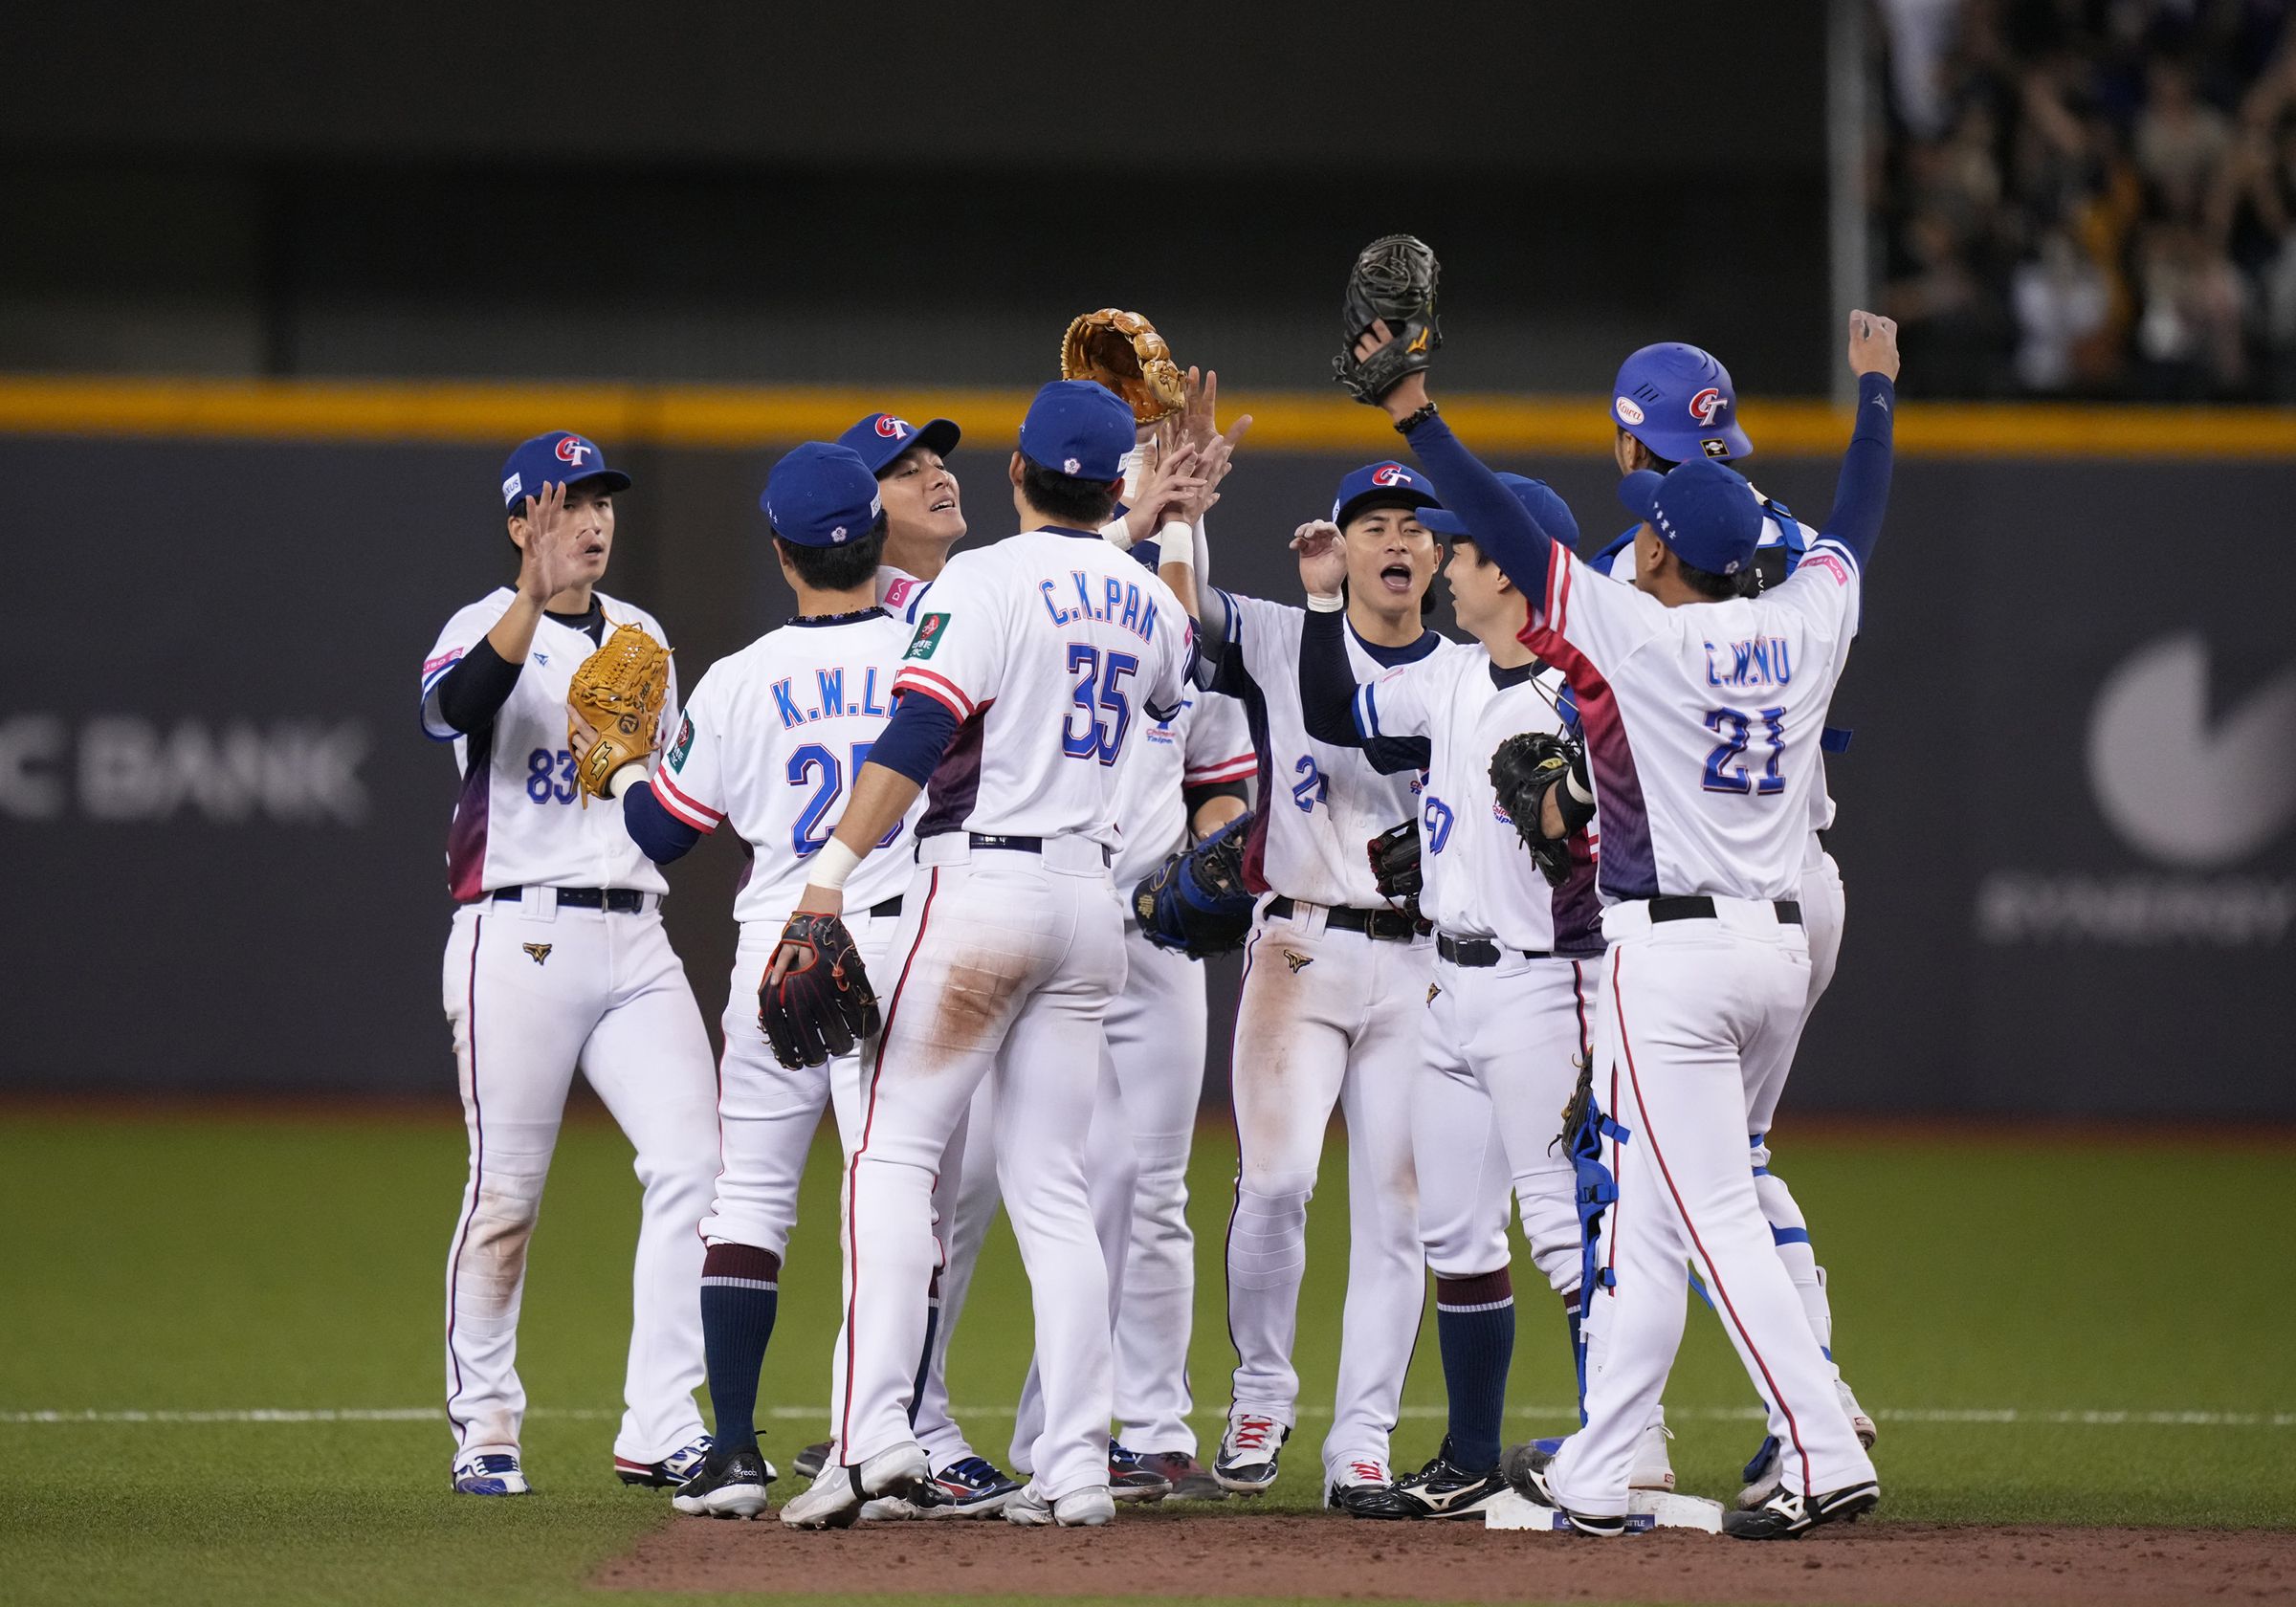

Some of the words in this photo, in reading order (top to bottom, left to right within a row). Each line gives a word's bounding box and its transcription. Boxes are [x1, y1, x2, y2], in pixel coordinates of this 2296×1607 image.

[1063, 643, 1138, 766] 35
[1701, 706, 1786, 795] 21
[80, 714, 371, 823] BANK
[527, 748, 579, 804] 83
